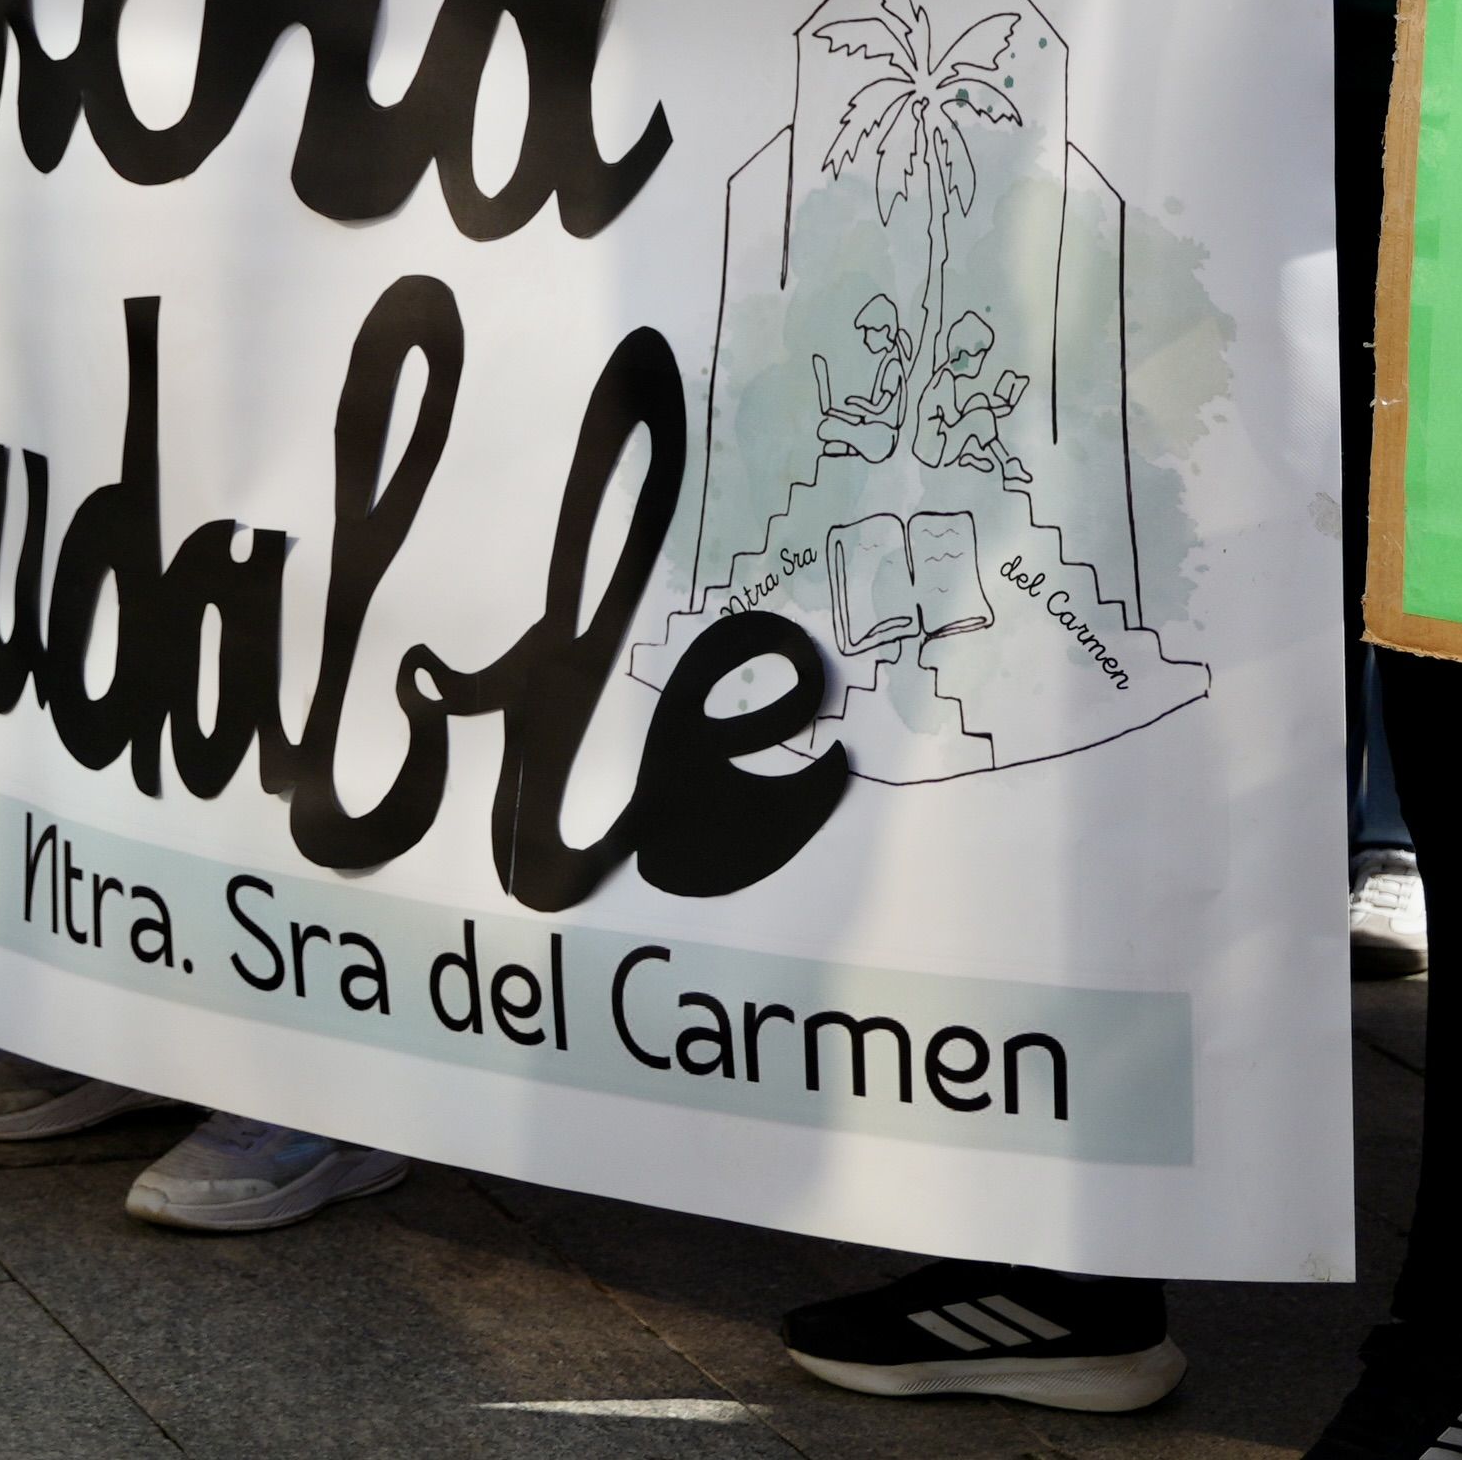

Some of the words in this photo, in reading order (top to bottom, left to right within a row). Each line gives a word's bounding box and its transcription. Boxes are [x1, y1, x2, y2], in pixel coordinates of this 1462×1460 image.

[779, 546, 818, 577] Sra
[1000, 555, 1046, 598] del
[1046, 590, 1130, 691] Carmen
[23, 812, 195, 974] Ntra.
[225, 874, 392, 1016] Sra
[428, 918, 569, 1052] del
[611, 944, 1070, 1122] Carmen
